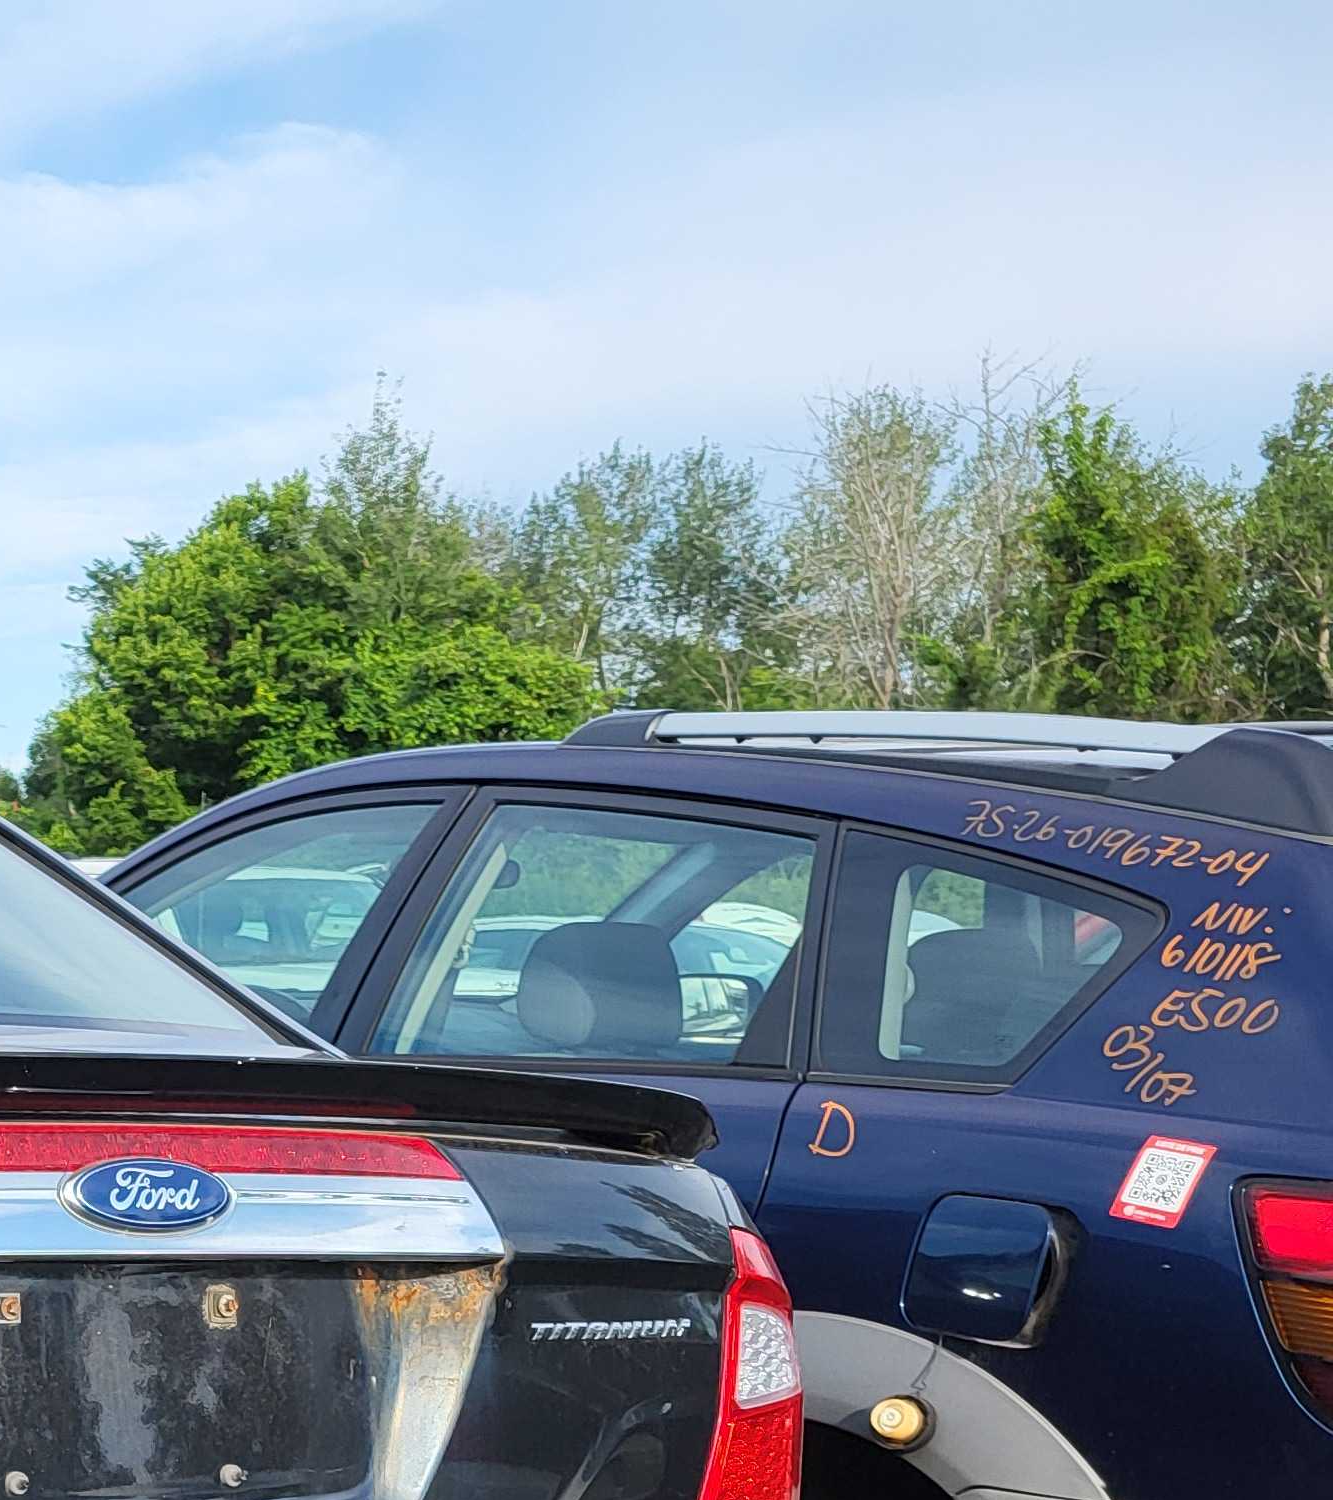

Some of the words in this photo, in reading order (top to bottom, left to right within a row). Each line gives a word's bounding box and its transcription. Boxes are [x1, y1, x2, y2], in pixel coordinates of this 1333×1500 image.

[1161, 934, 1282, 980] 610118
[808, 1101, 856, 1157] D
[109, 1167, 200, 1211] Ford
[531, 1317, 691, 1341] TITANIUM
